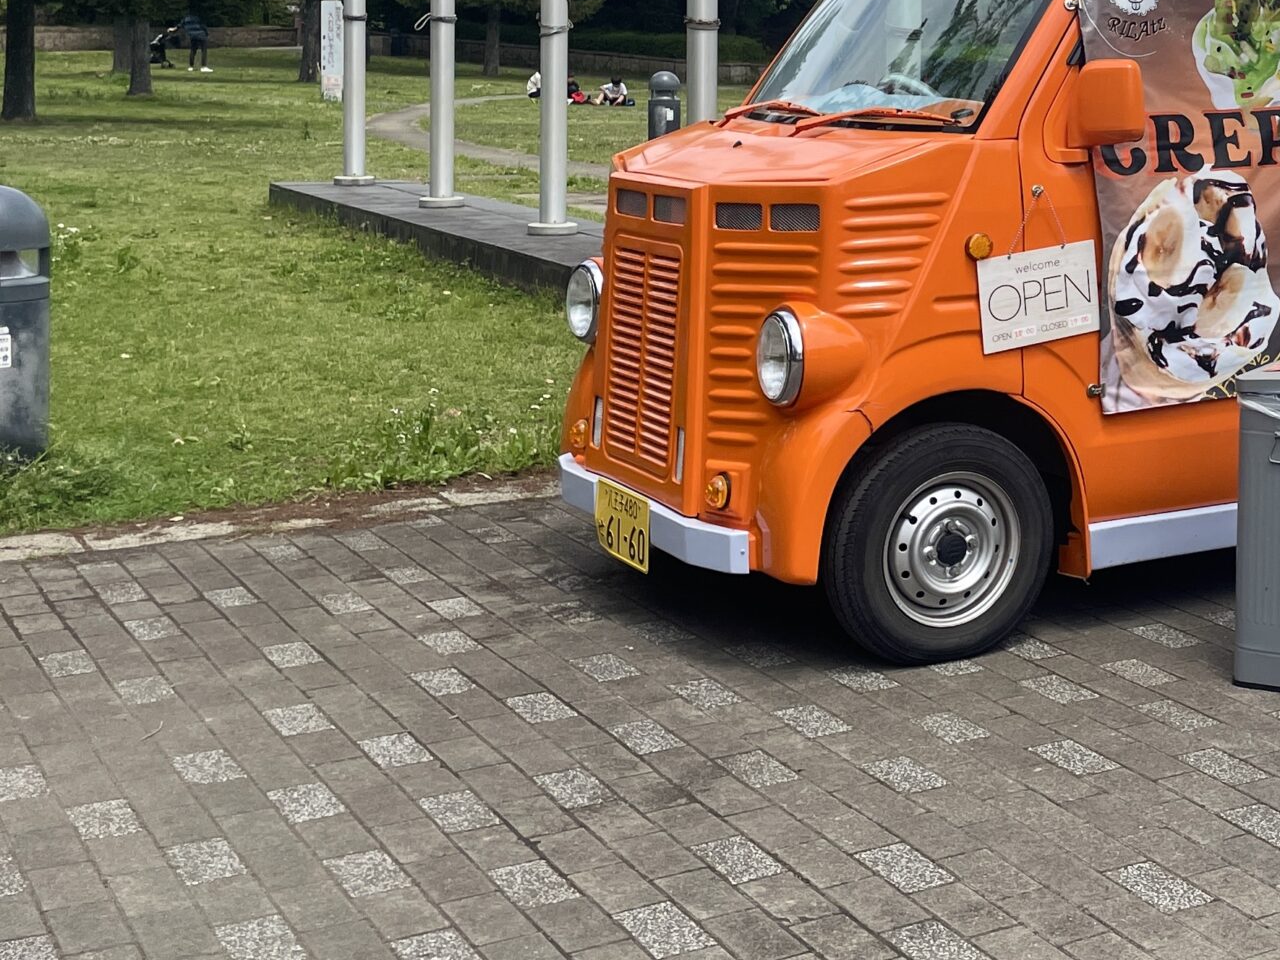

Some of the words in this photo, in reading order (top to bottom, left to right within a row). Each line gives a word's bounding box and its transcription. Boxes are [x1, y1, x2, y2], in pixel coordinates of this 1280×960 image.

[1015, 260, 1061, 274] welcome
[988, 269, 1091, 321] OPEN
[992, 332, 1013, 343] OPEN
[1040, 320, 1068, 333] CLOSED
